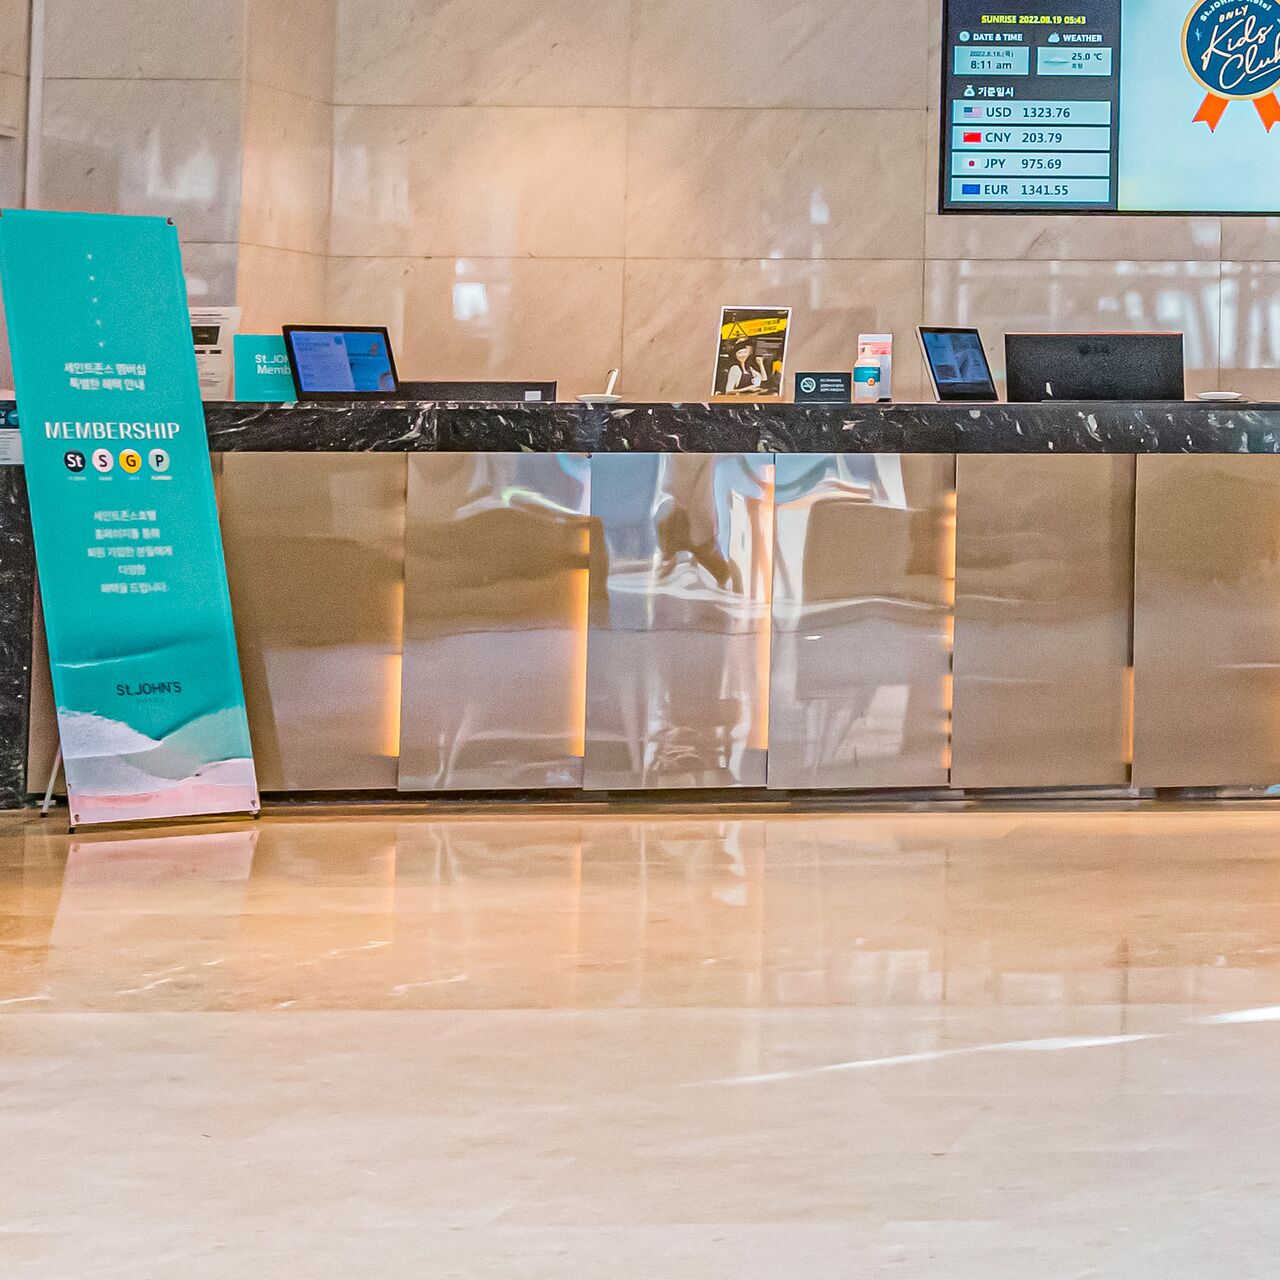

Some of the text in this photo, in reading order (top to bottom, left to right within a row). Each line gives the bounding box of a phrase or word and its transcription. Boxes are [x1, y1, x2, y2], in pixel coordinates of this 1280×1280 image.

[1218, 5, 1249, 22] ONLY
[981, 15, 1017, 24] SUNRISE
[973, 33, 994, 41] DATE
[1003, 34, 1023, 42] TIME
[1063, 34, 1102, 42] WEATHER
[1201, 15, 1274, 71] Kids
[1071, 52, 1090, 61] 25.0
[970, 60, 1012, 70] 8:11 am
[986, 107, 1071, 118] USD 1323.76
[985, 132, 1062, 143] CNY 203.79
[984, 158, 1062, 169] JPY 975.69
[984, 184, 1069, 195] EUR 1341.55
[44, 421, 180, 440] MEMBERSHIP
[66, 454, 164, 468] St S G P
